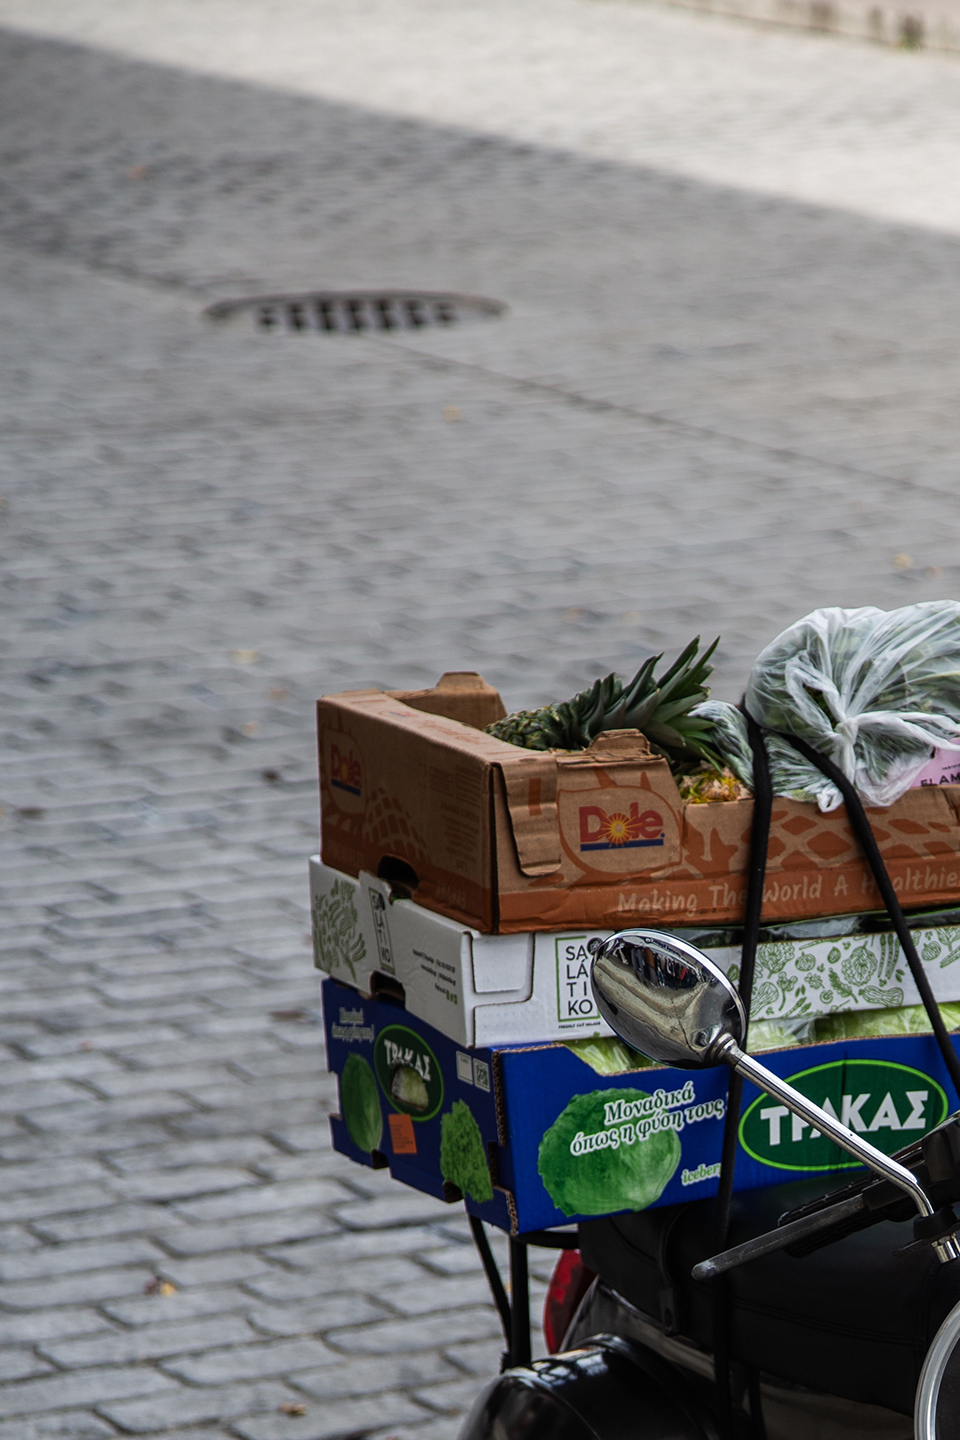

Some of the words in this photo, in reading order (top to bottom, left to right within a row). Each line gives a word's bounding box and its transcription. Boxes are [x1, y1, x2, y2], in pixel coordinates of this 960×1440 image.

[616, 887, 698, 918] Making
[762, 873, 823, 902] World
[833, 873, 849, 897] A
[565, 944, 588, 961] SA
[566, 957, 589, 980] LÁ
[567, 999, 593, 1016] KO
[605, 1081, 694, 1124] Μοναδικά
[572, 1131, 619, 1154] όπως
[621, 1125, 635, 1143] η
[637, 1109, 683, 1139] φύση
[682, 1162, 722, 1185] iceber
